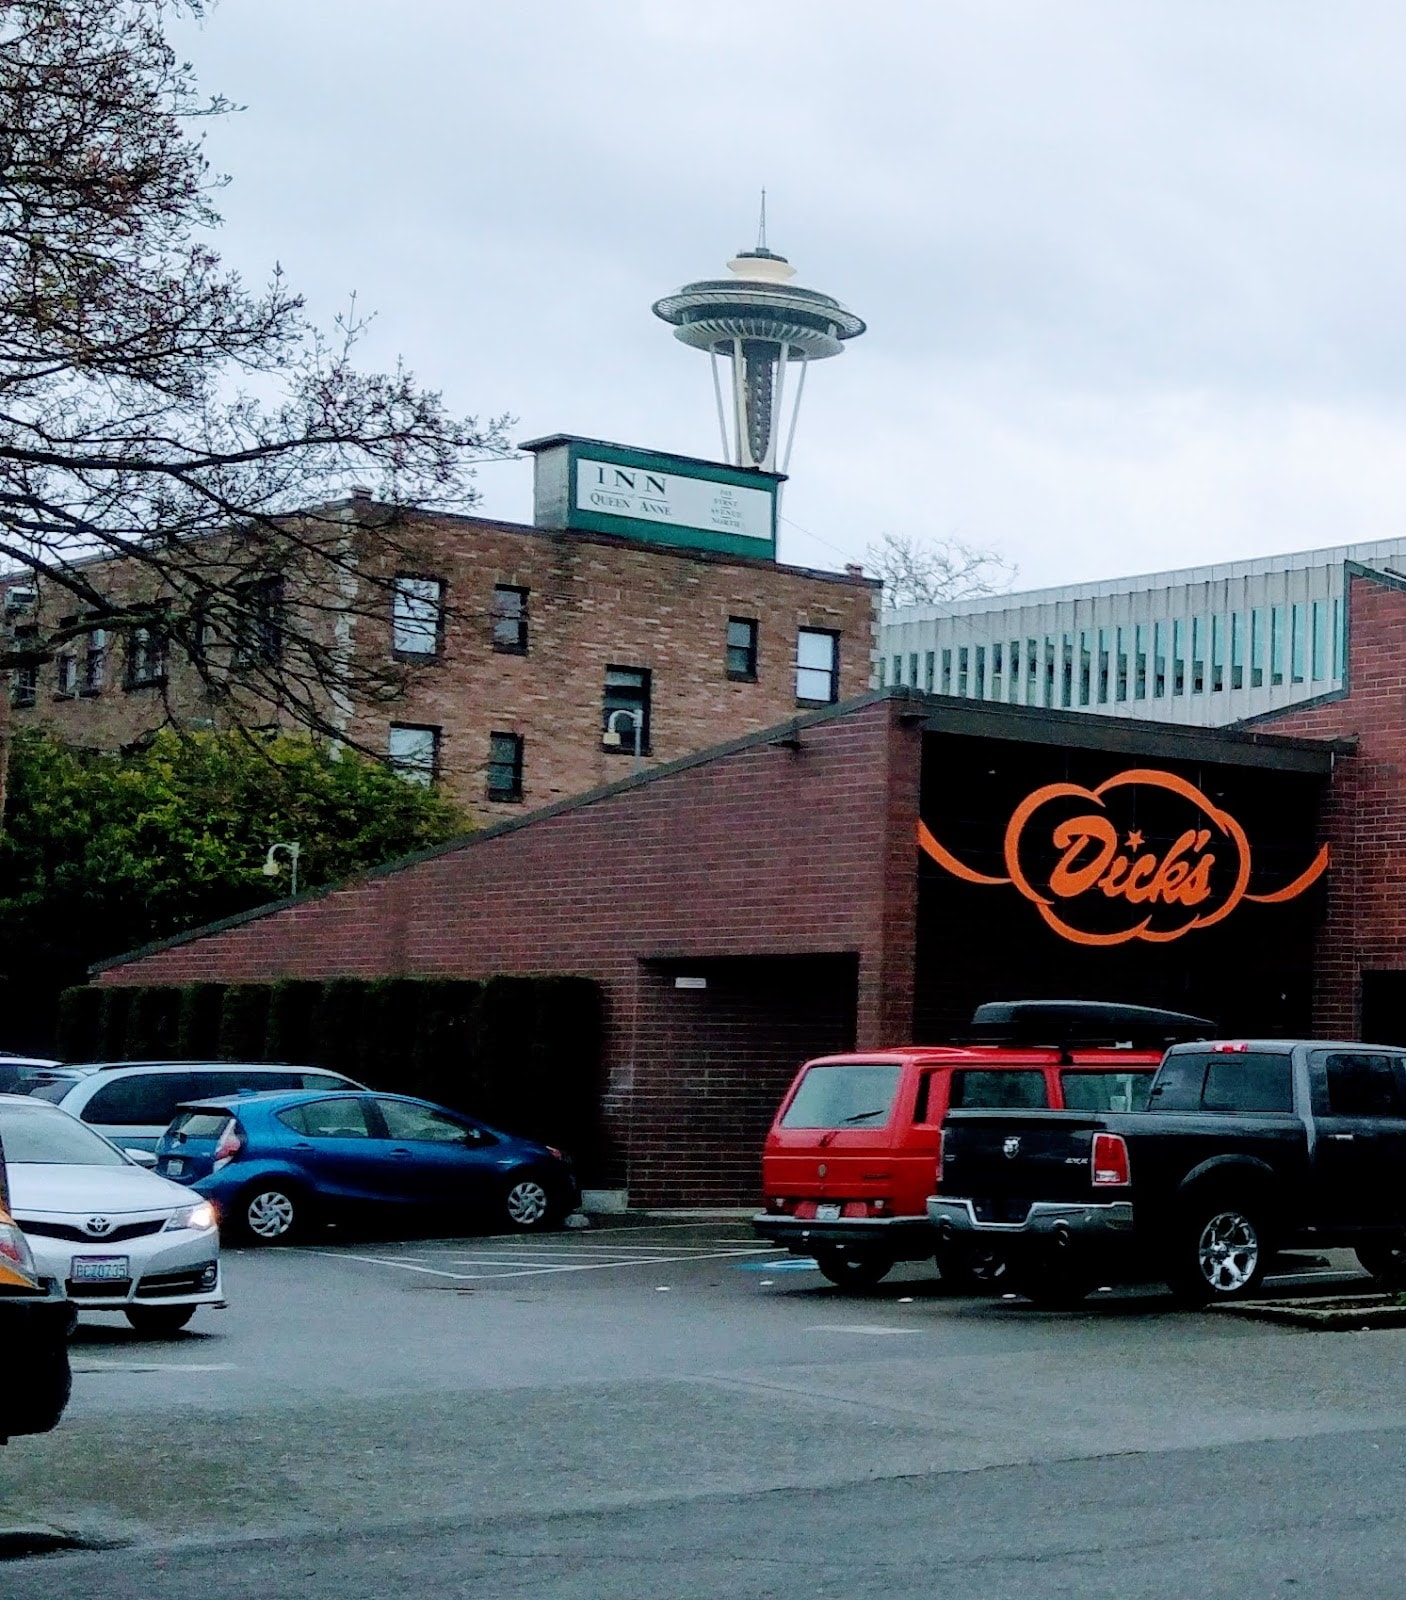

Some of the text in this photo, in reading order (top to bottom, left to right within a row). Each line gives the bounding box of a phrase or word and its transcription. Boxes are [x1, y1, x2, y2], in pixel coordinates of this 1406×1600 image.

[597, 466, 667, 495] INN
[590, 492, 672, 516] QUEEN ANNE
[1050, 814, 1216, 906] Dick's
